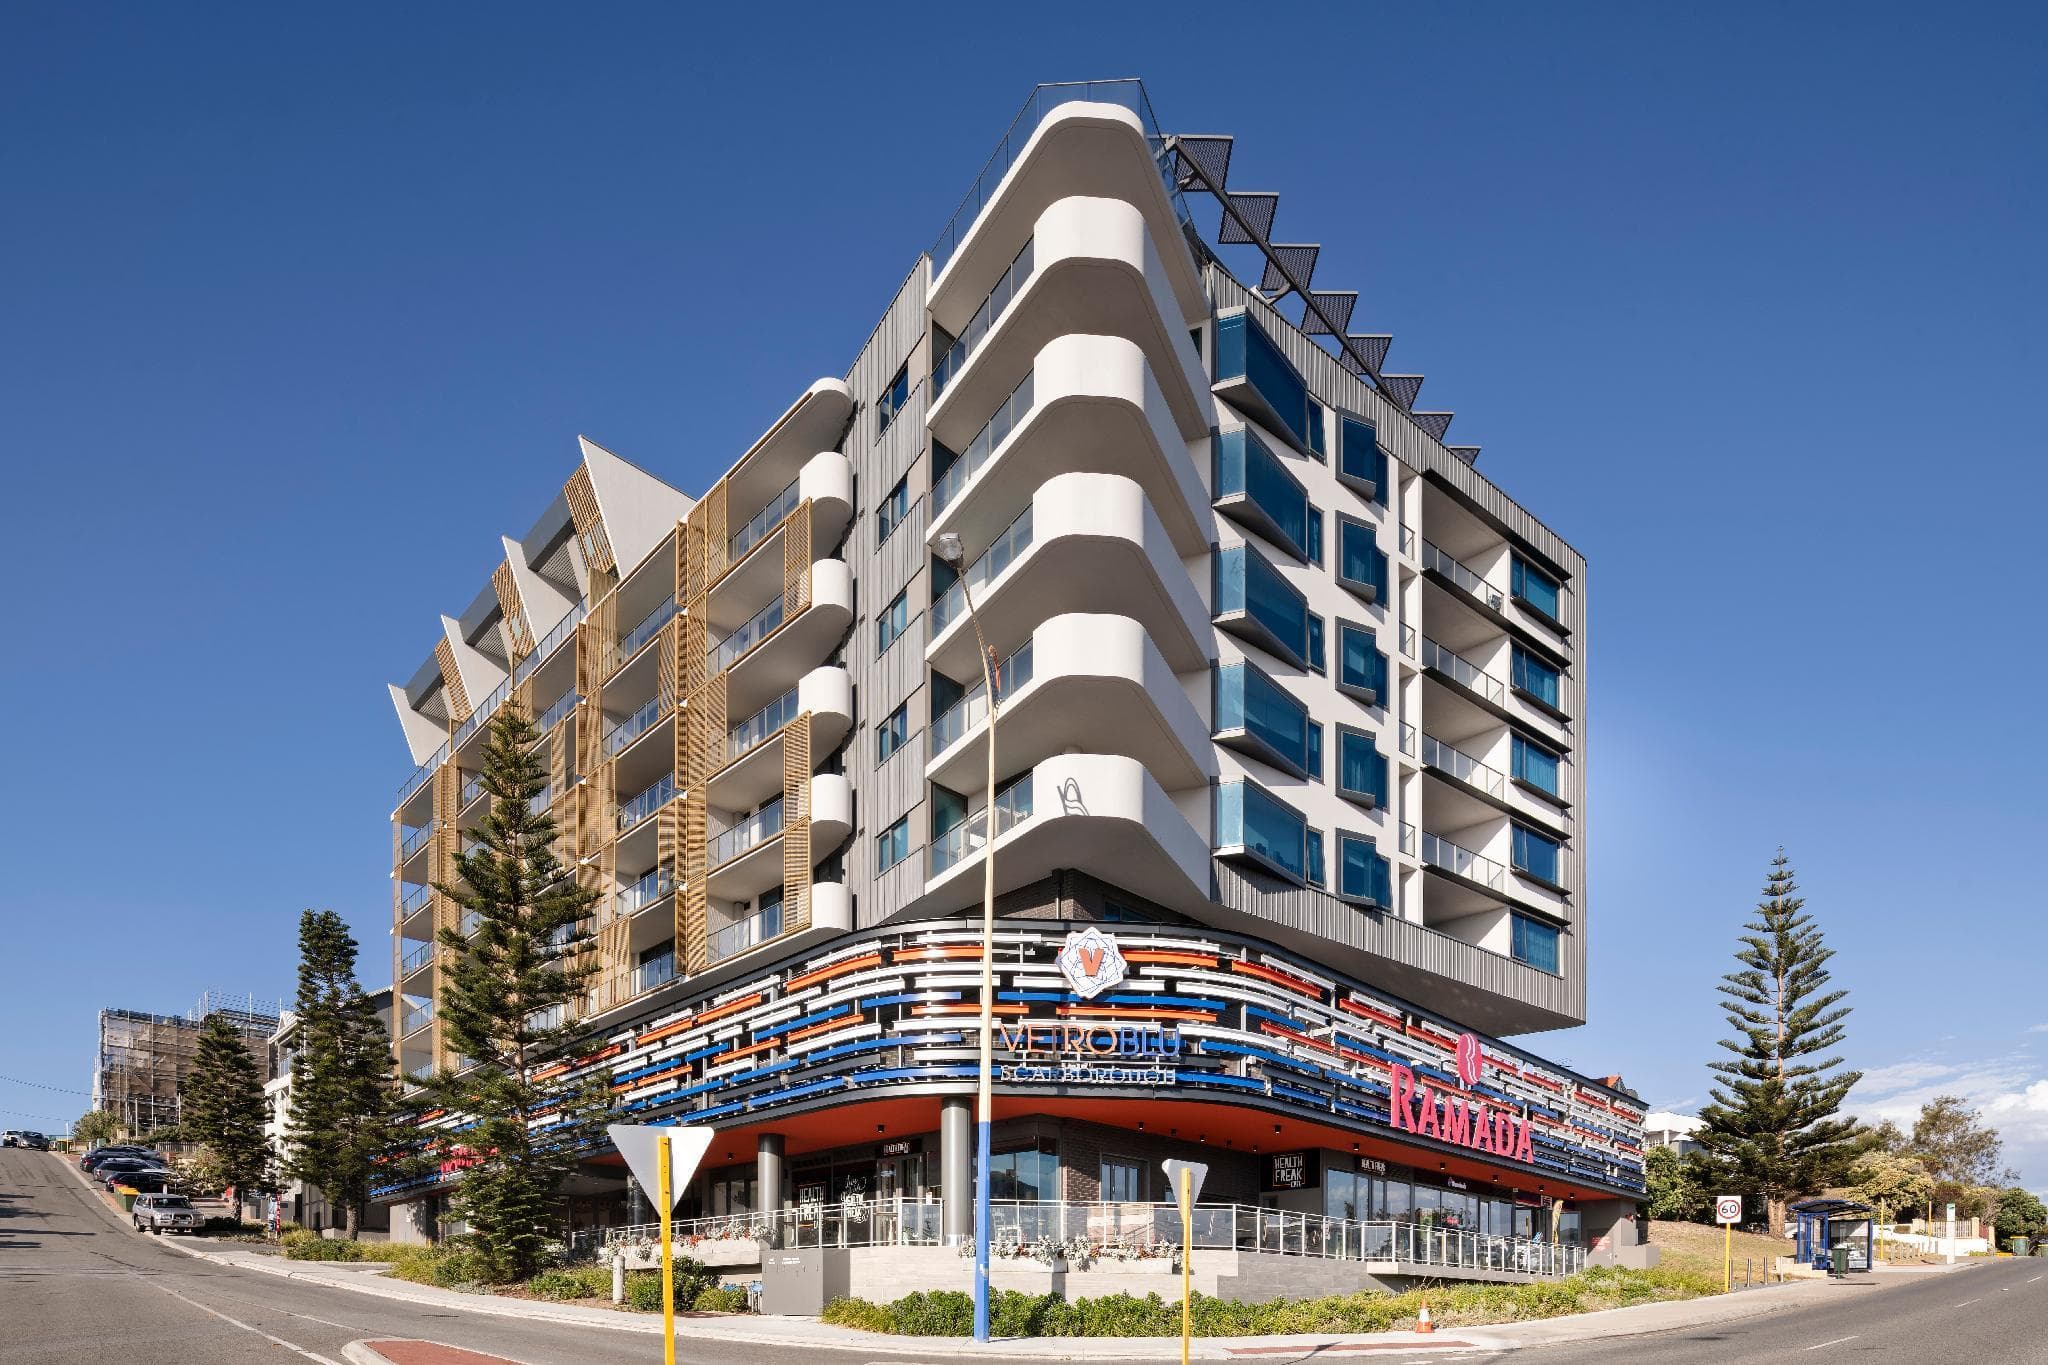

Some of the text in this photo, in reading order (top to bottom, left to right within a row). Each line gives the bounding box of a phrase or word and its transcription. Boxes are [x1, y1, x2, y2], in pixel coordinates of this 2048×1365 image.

[1078, 947, 1105, 977] V
[999, 1023, 1181, 1057] VETROBLU
[1390, 1063, 1534, 1164] RAMADA
[1274, 1155, 1303, 1170] HEALTH
[1275, 1168, 1303, 1183] FREAK
[1721, 1204, 1736, 1213] 60
